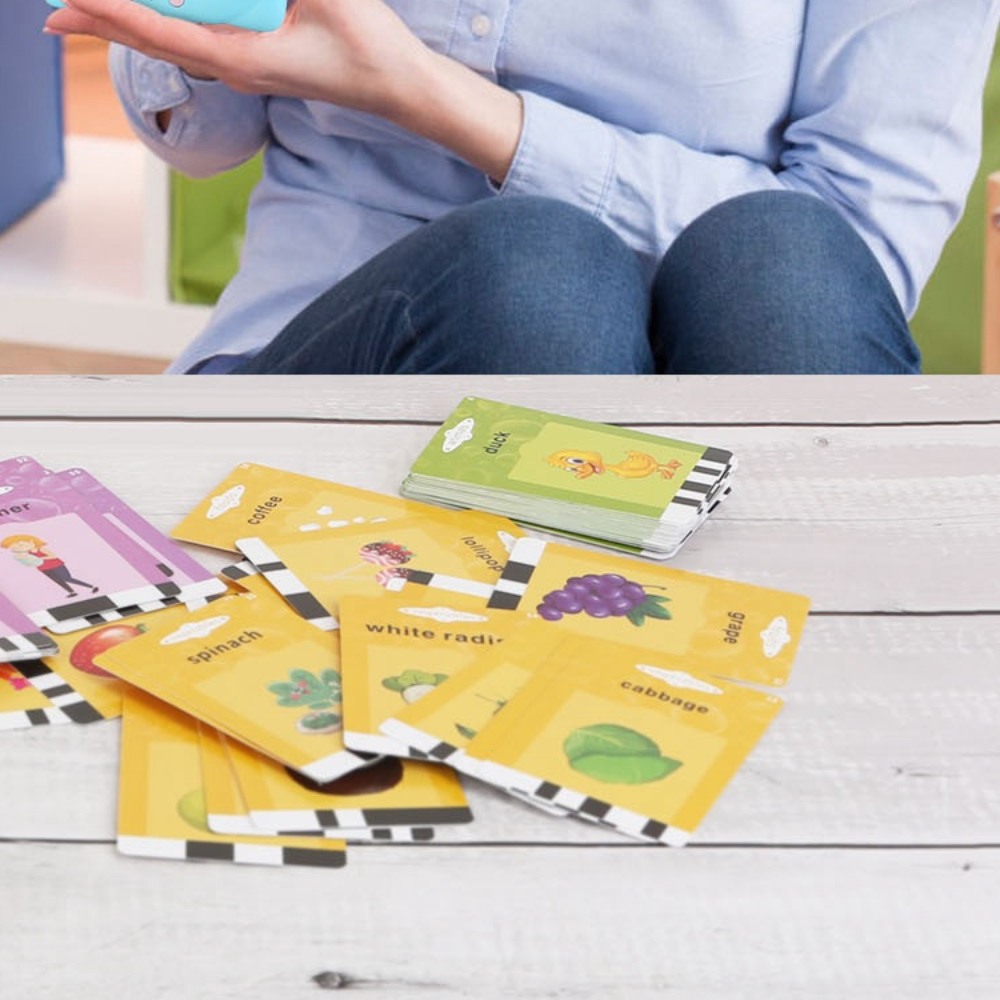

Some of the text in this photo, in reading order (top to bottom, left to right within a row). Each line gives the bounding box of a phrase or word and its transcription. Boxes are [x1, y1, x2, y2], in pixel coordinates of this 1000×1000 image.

[481, 430, 511, 454] duck
[247, 495, 283, 525] coffee
[461, 536, 504, 573] lollipop
[366, 623, 435, 640] white
[721, 610, 747, 645] grape
[186, 629, 264, 665] spinach
[620, 680, 710, 714] cabbage
